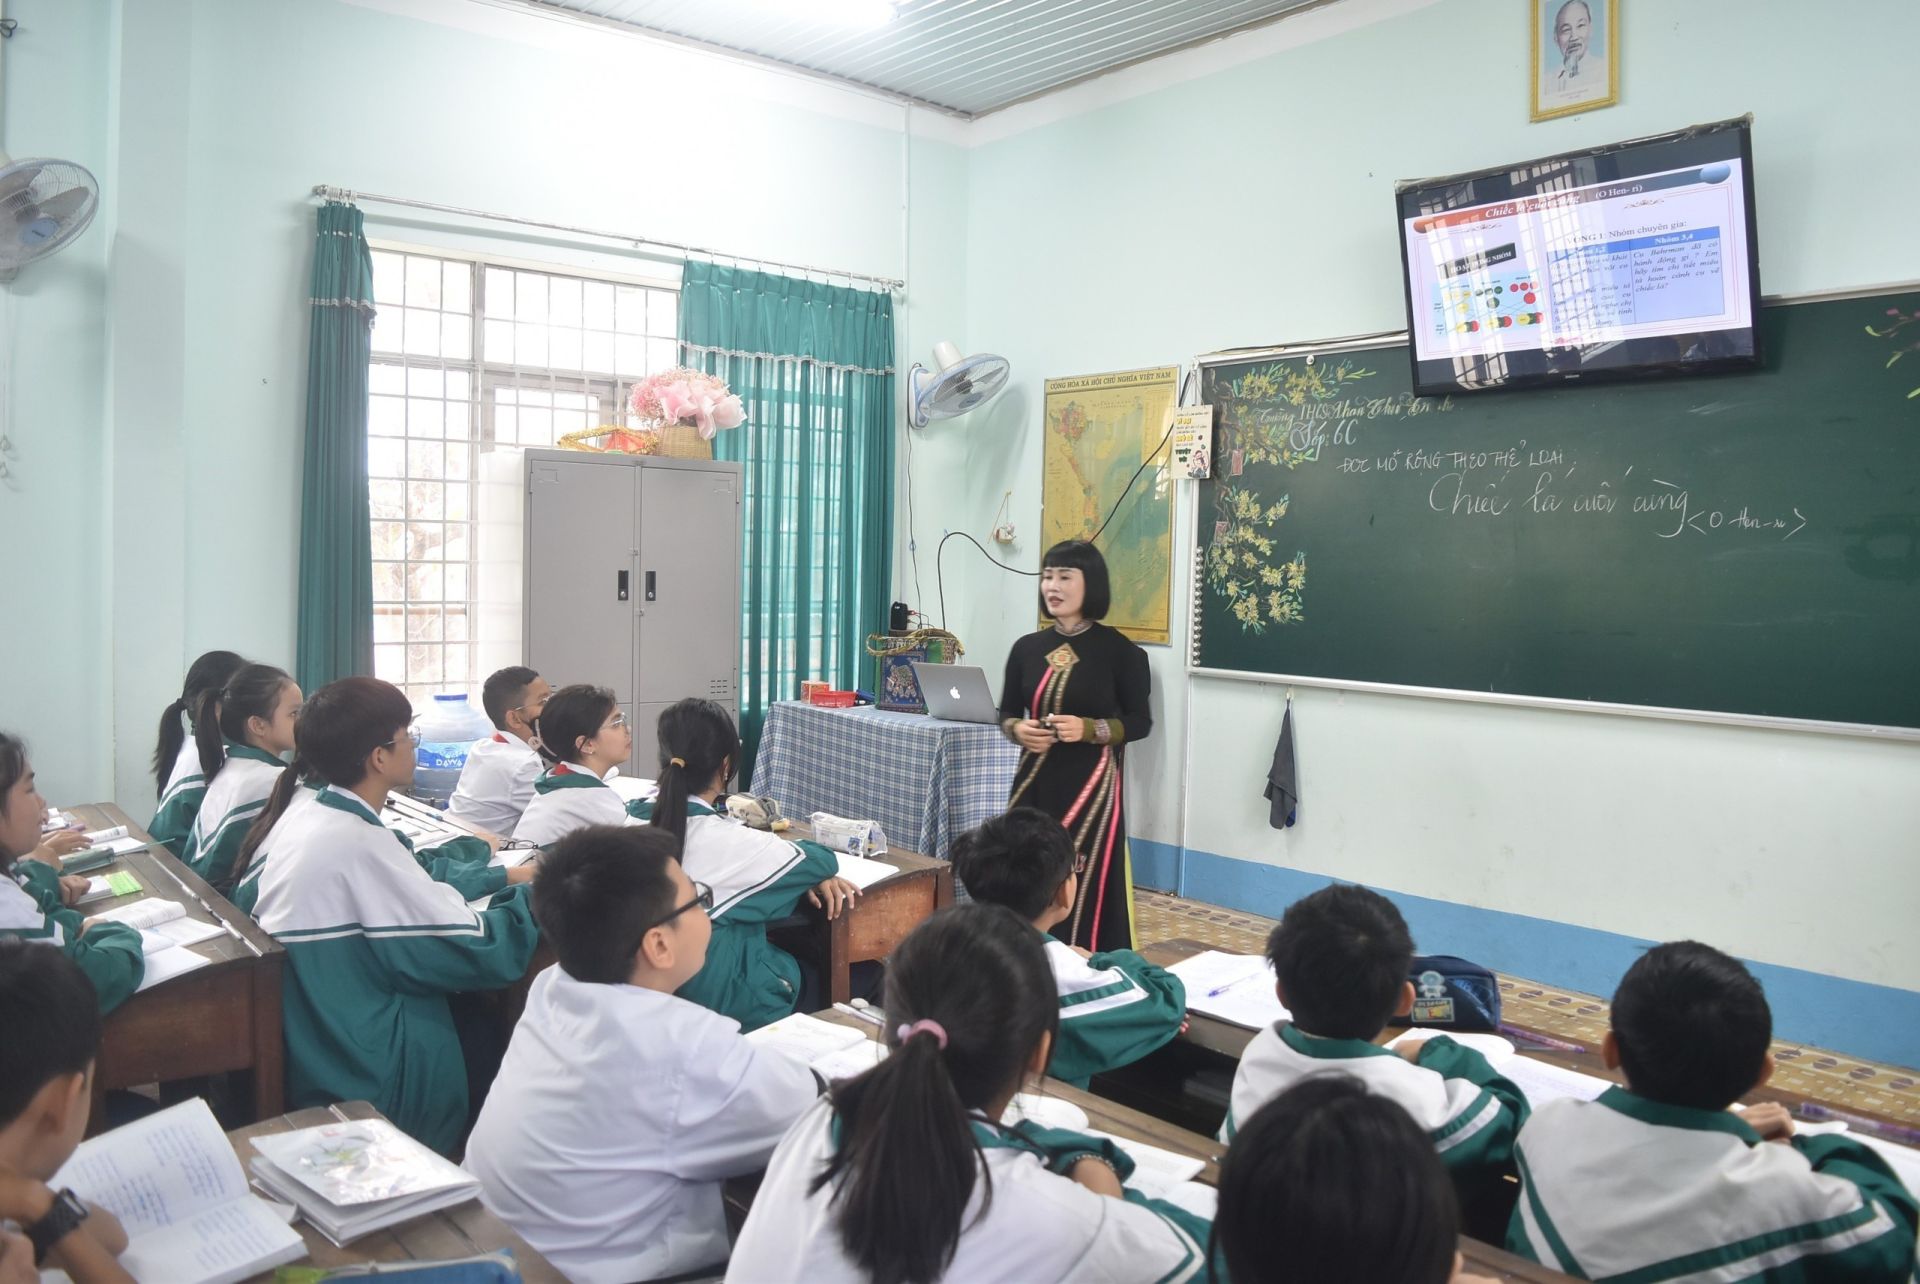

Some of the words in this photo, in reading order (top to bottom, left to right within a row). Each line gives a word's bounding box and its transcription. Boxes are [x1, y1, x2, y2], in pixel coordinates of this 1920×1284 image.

[1485, 204, 1513, 218] Chiếc
[1609, 228, 1635, 239] Nhóm
[1637, 222, 1668, 235] chuyên
[1670, 220, 1688, 231] gia:
[1067, 380, 1080, 388] HÒA
[1091, 378, 1102, 386] HỘI
[1103, 374, 1116, 384] CHỦ
[1117, 374, 1138, 383] NGHĨA
[1139, 372, 1155, 381] VIỆT
[1155, 371, 1172, 379] NAM
[1333, 419, 1359, 446] 6C
[1445, 451, 1487, 470] THEO
[1488, 440, 1526, 468] THỂ
[1429, 468, 1513, 516] Chiếc
[1633, 478, 1689, 538] cùng
